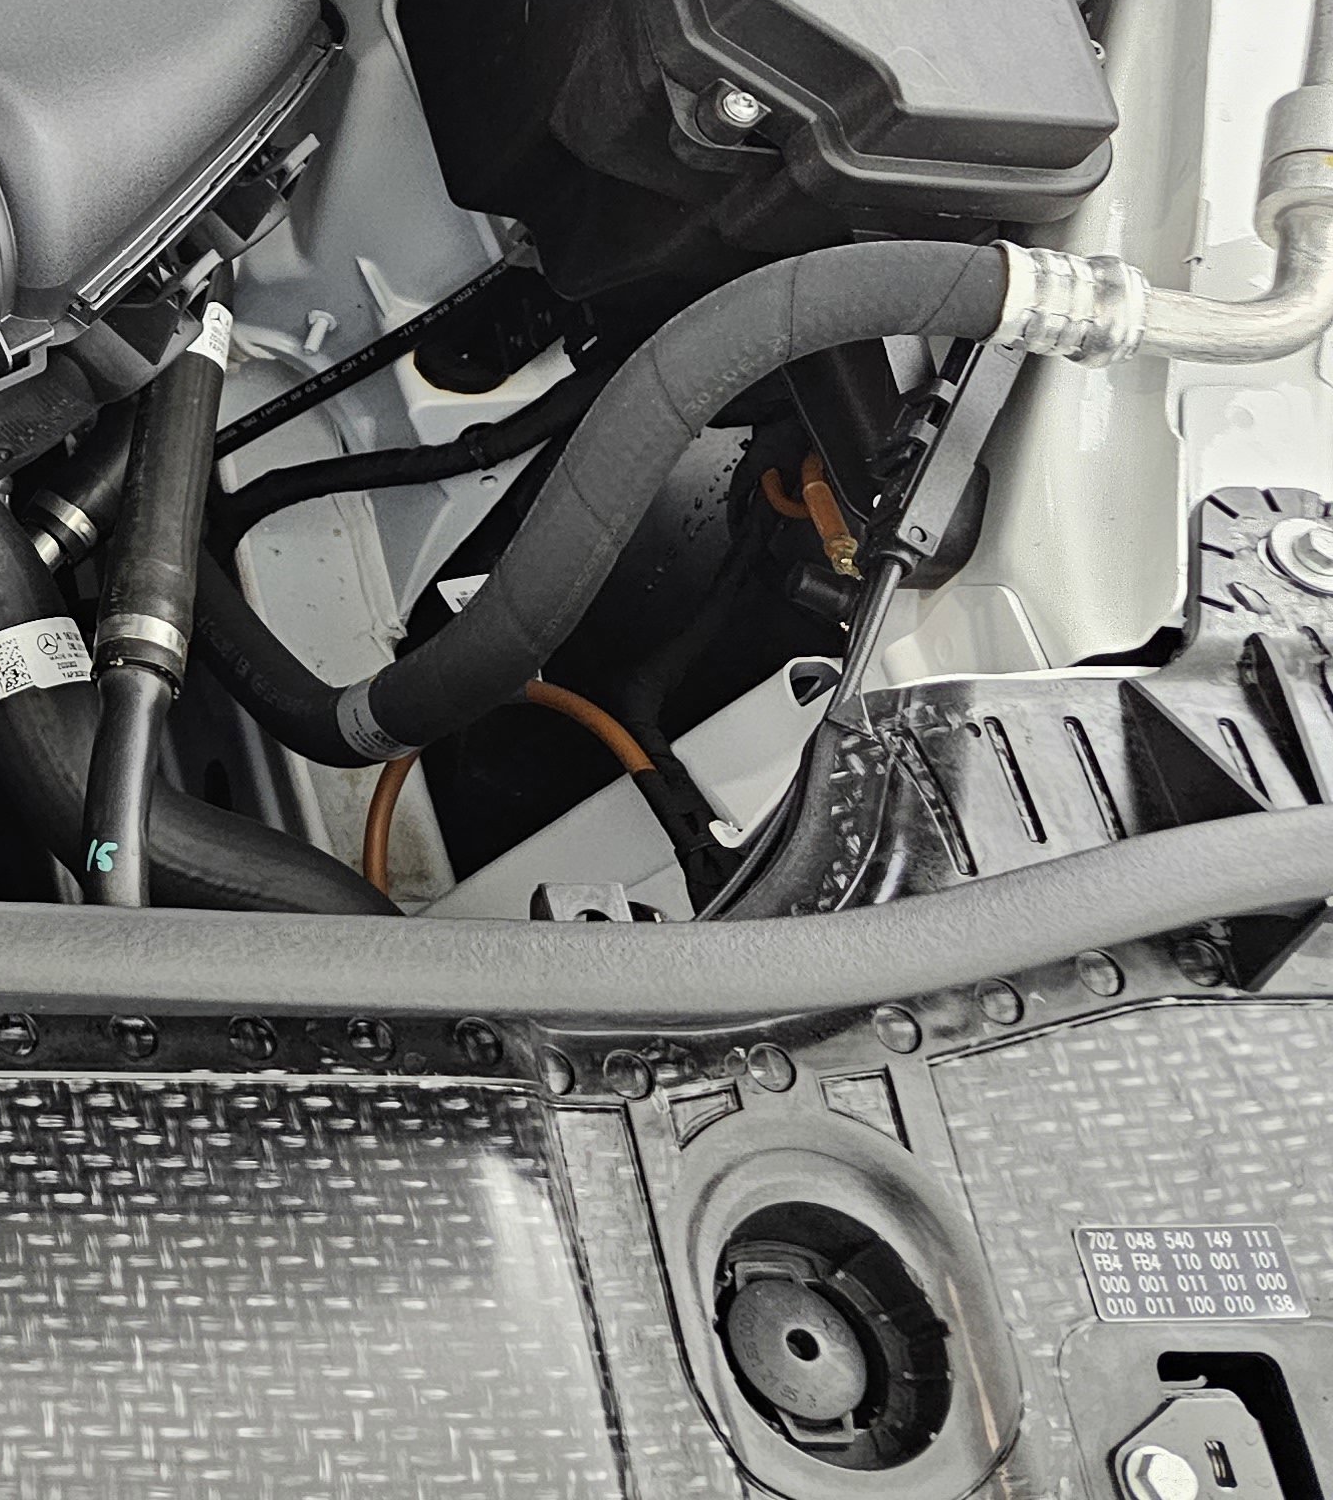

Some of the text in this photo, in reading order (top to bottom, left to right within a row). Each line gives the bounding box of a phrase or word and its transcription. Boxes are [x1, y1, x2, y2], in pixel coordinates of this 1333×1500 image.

[87, 838, 118, 872] 15
[1086, 1230, 1272, 1250] 702 048 540 149 111
[1092, 1251, 1280, 1272] FB4 FB4 110 001 101
[1099, 1273, 1288, 1293] 000 001 011 101 000
[1106, 1294, 1295, 1316] 010 011 100 010 138
